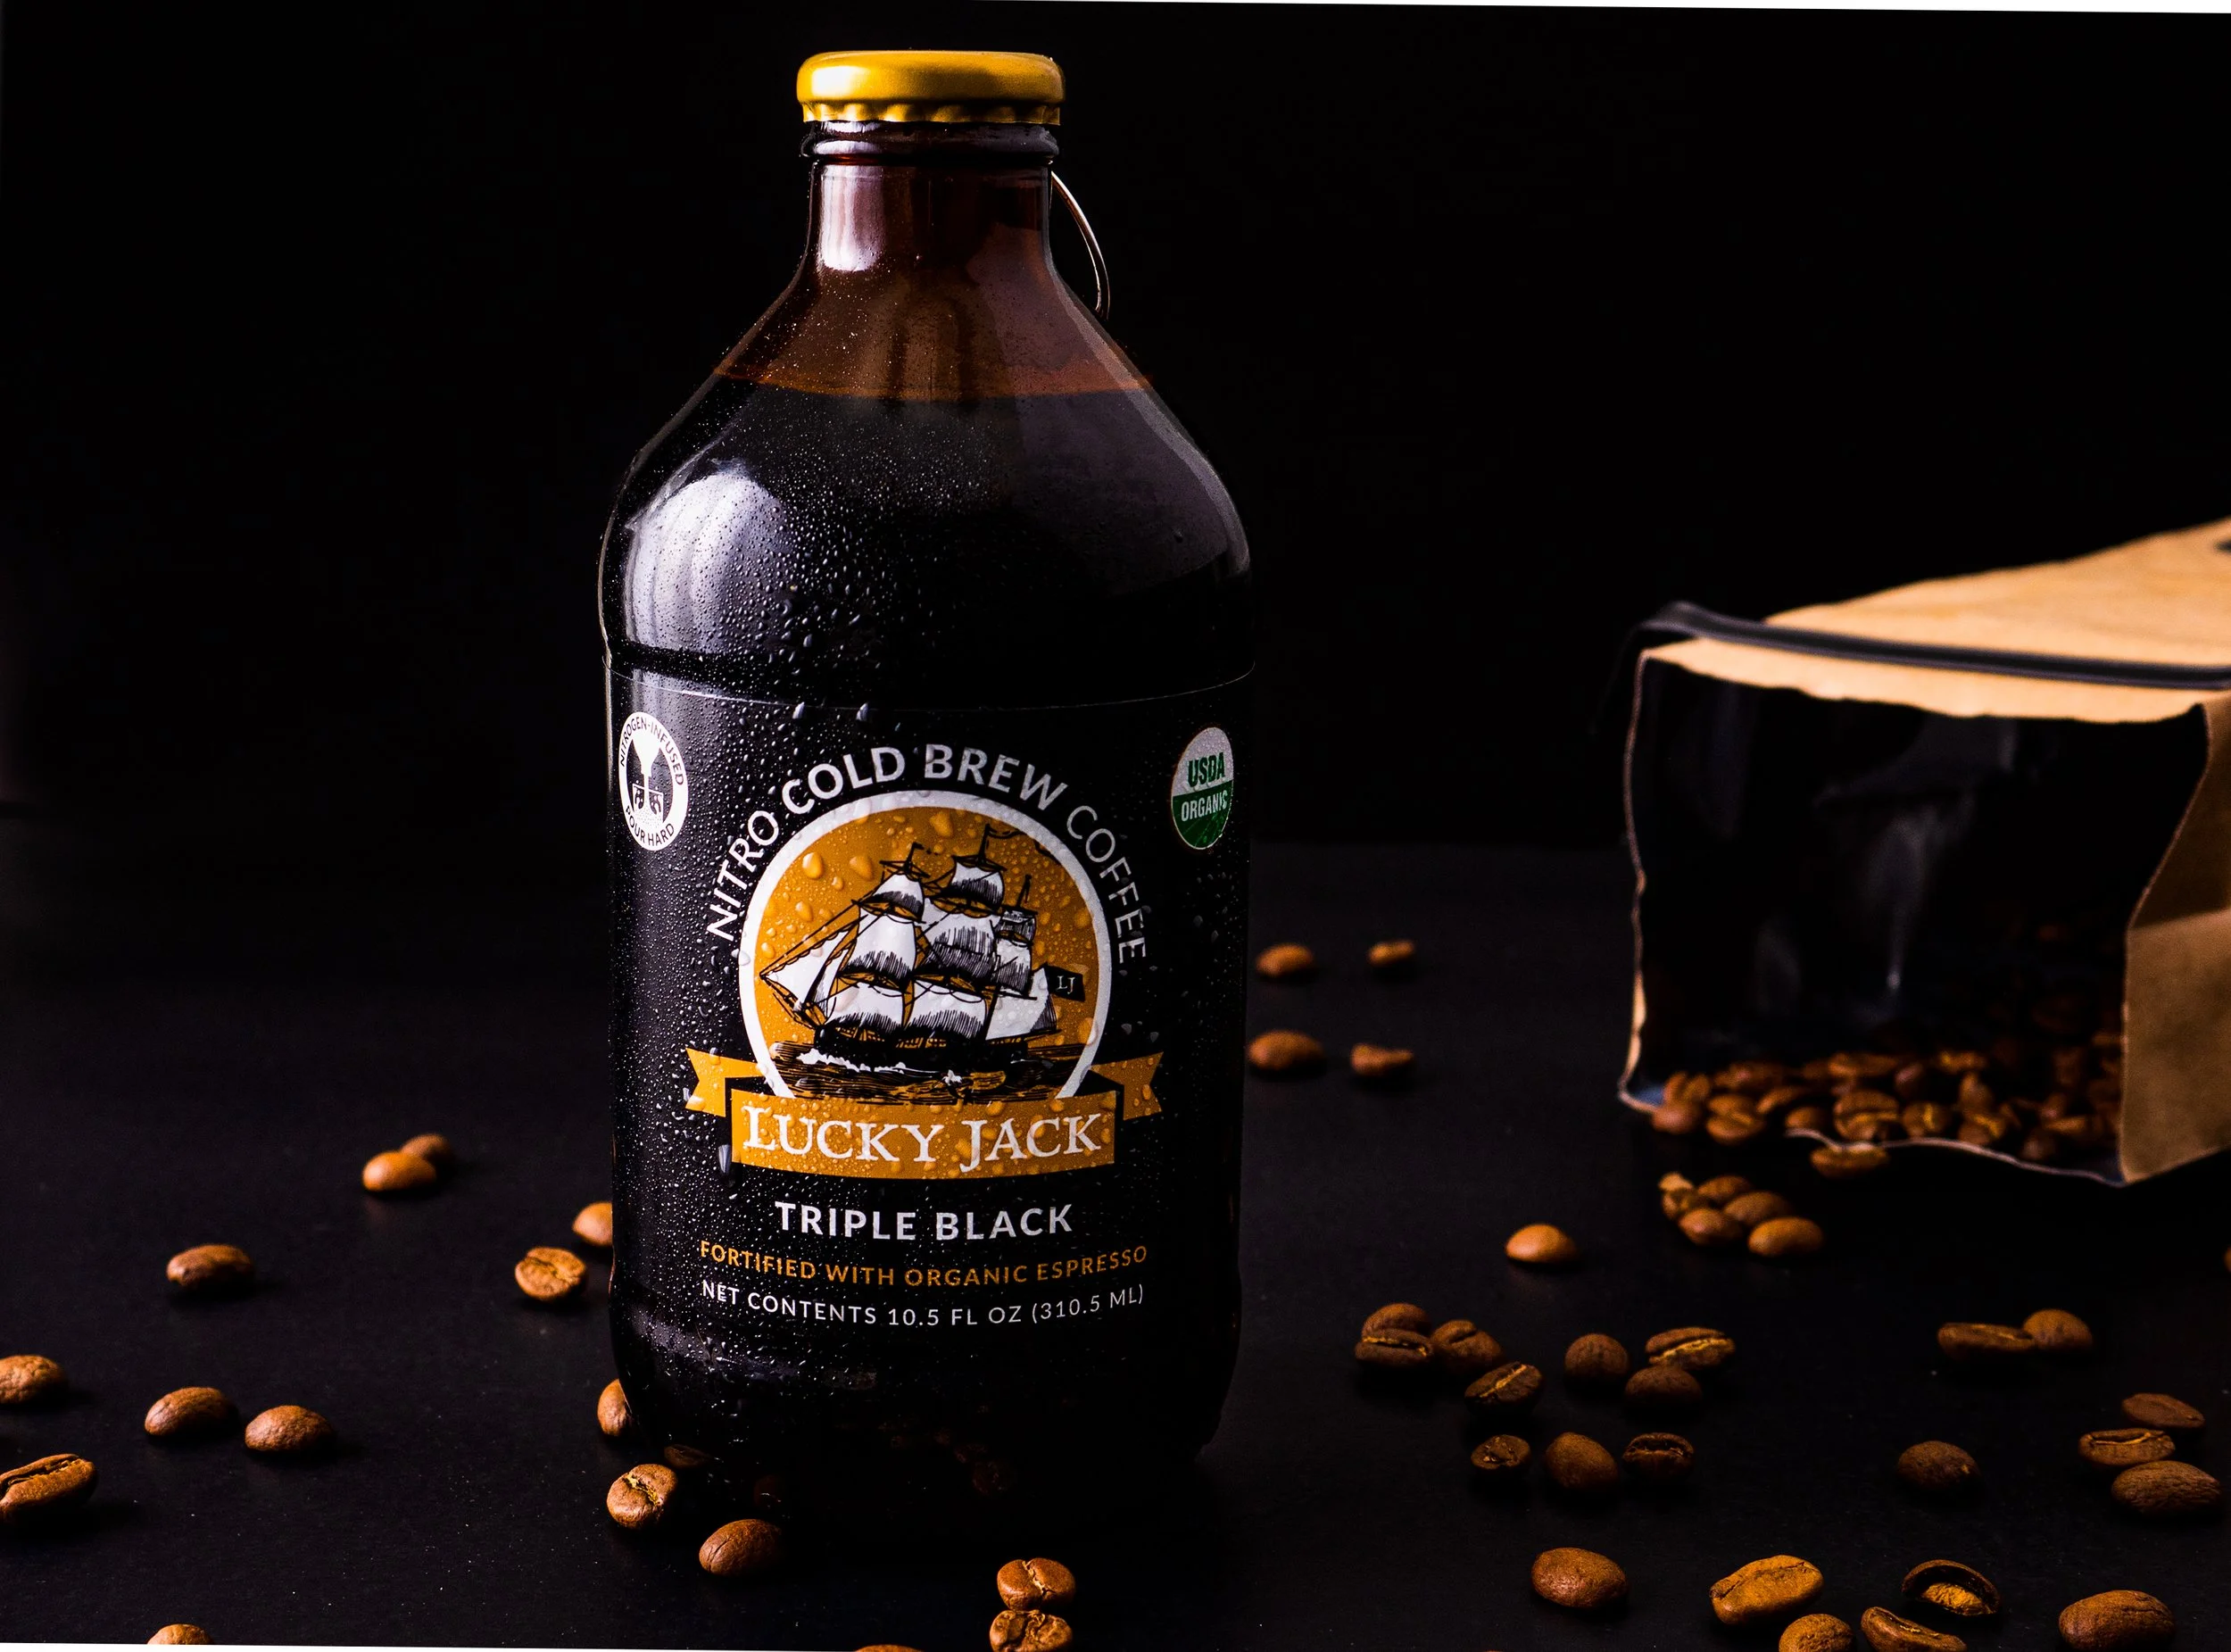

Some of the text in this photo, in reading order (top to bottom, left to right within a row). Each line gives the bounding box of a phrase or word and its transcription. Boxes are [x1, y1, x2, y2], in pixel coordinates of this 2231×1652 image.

[620, 717, 684, 785] NITROGEN-INFUSED
[1188, 751, 1225, 787] USDA
[626, 805, 675, 846] POUR HARD
[1181, 790, 1228, 822] ORGANIC
[708, 743, 1147, 965] NITRO COLD BREW COFFEE
[1057, 975, 1075, 994] LJ
[742, 1106, 1101, 1171] LUCKY JACK
[775, 1200, 1073, 1241] TRIPLE BLACK
[700, 1241, 1148, 1286] FORTIFIED WITH ORGANIC ESPRESSO
[702, 1283, 1144, 1326] NET CONTENTS 10.5 FL OZ (310.5 ML)
